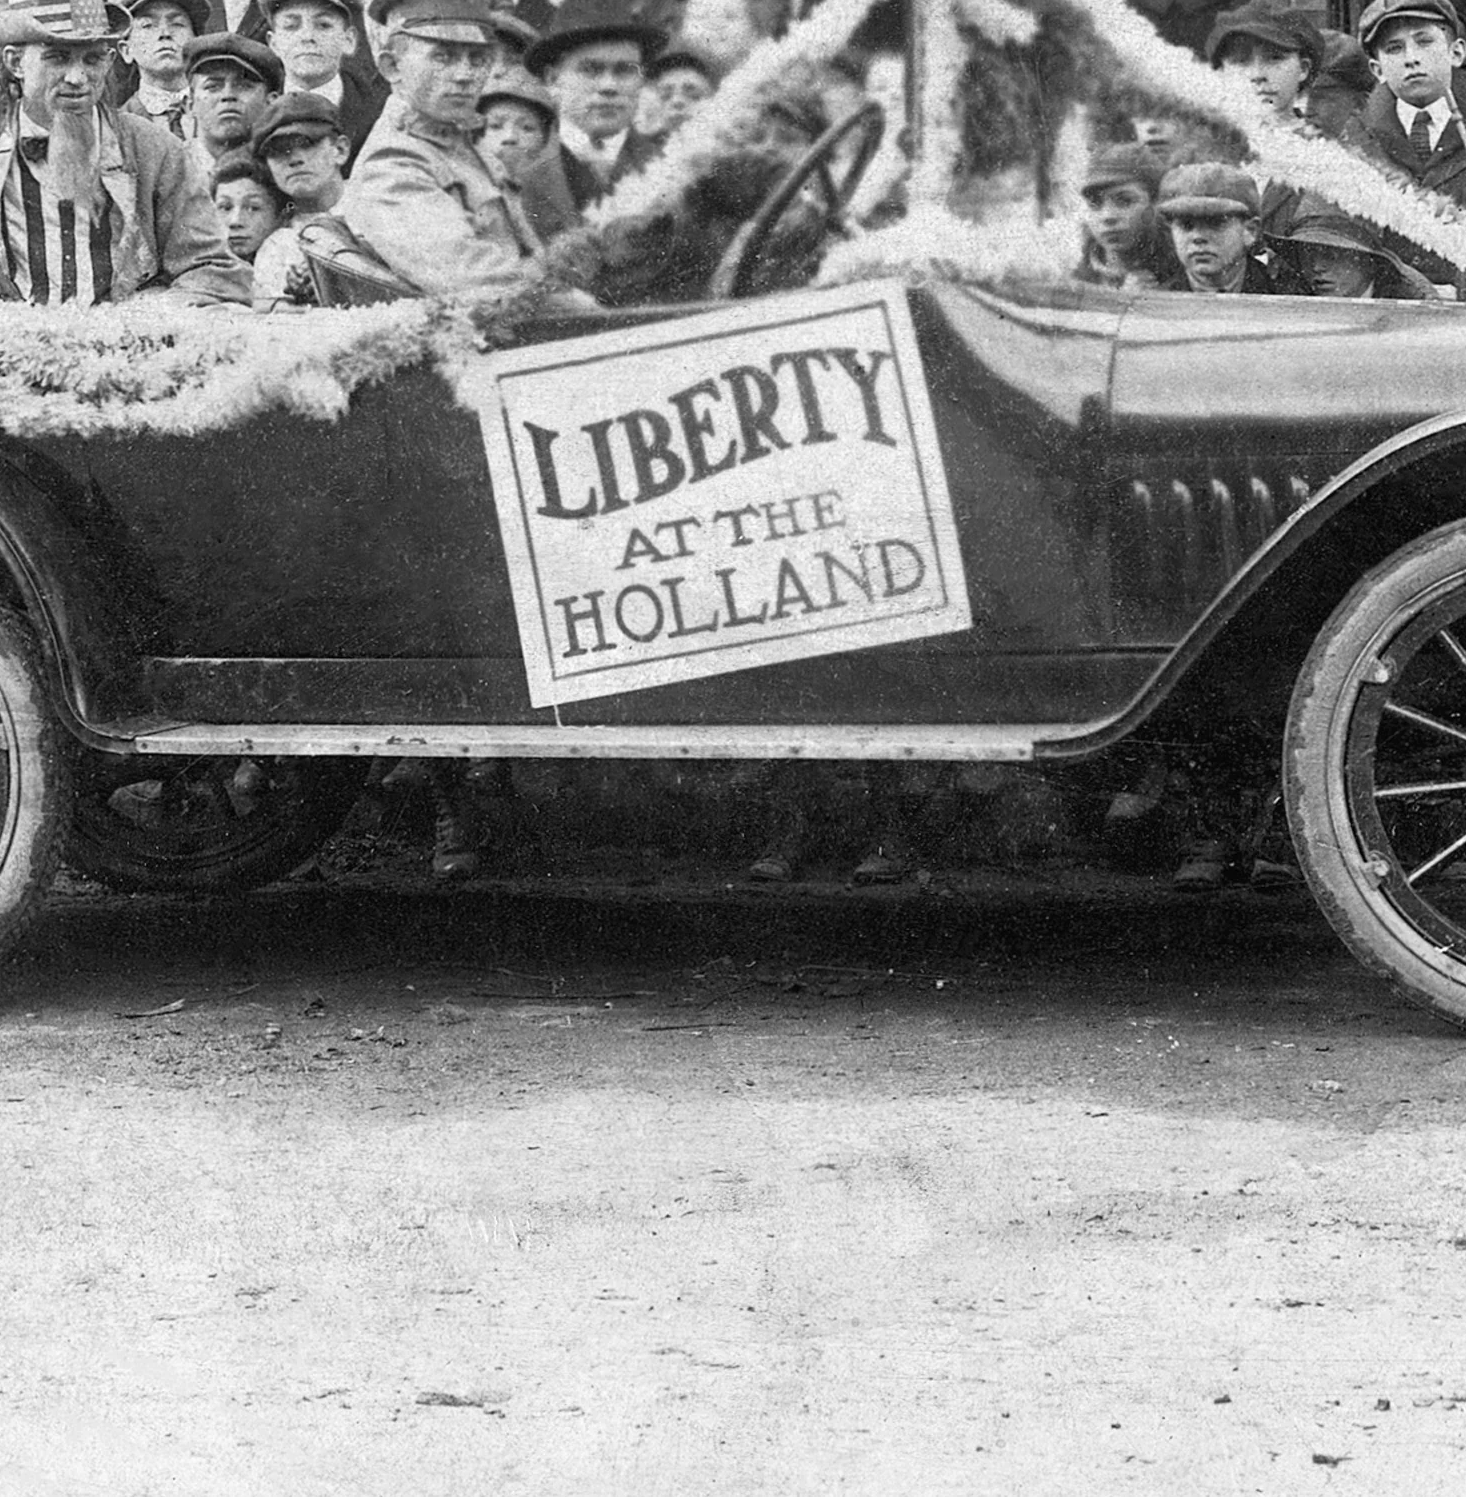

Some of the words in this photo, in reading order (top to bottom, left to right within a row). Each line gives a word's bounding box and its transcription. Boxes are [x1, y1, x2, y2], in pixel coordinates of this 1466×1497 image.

[522, 346, 898, 521] LIBERTY
[614, 515, 702, 570] AT
[712, 489, 849, 548] THE
[553, 537, 926, 659] HOLLAND
